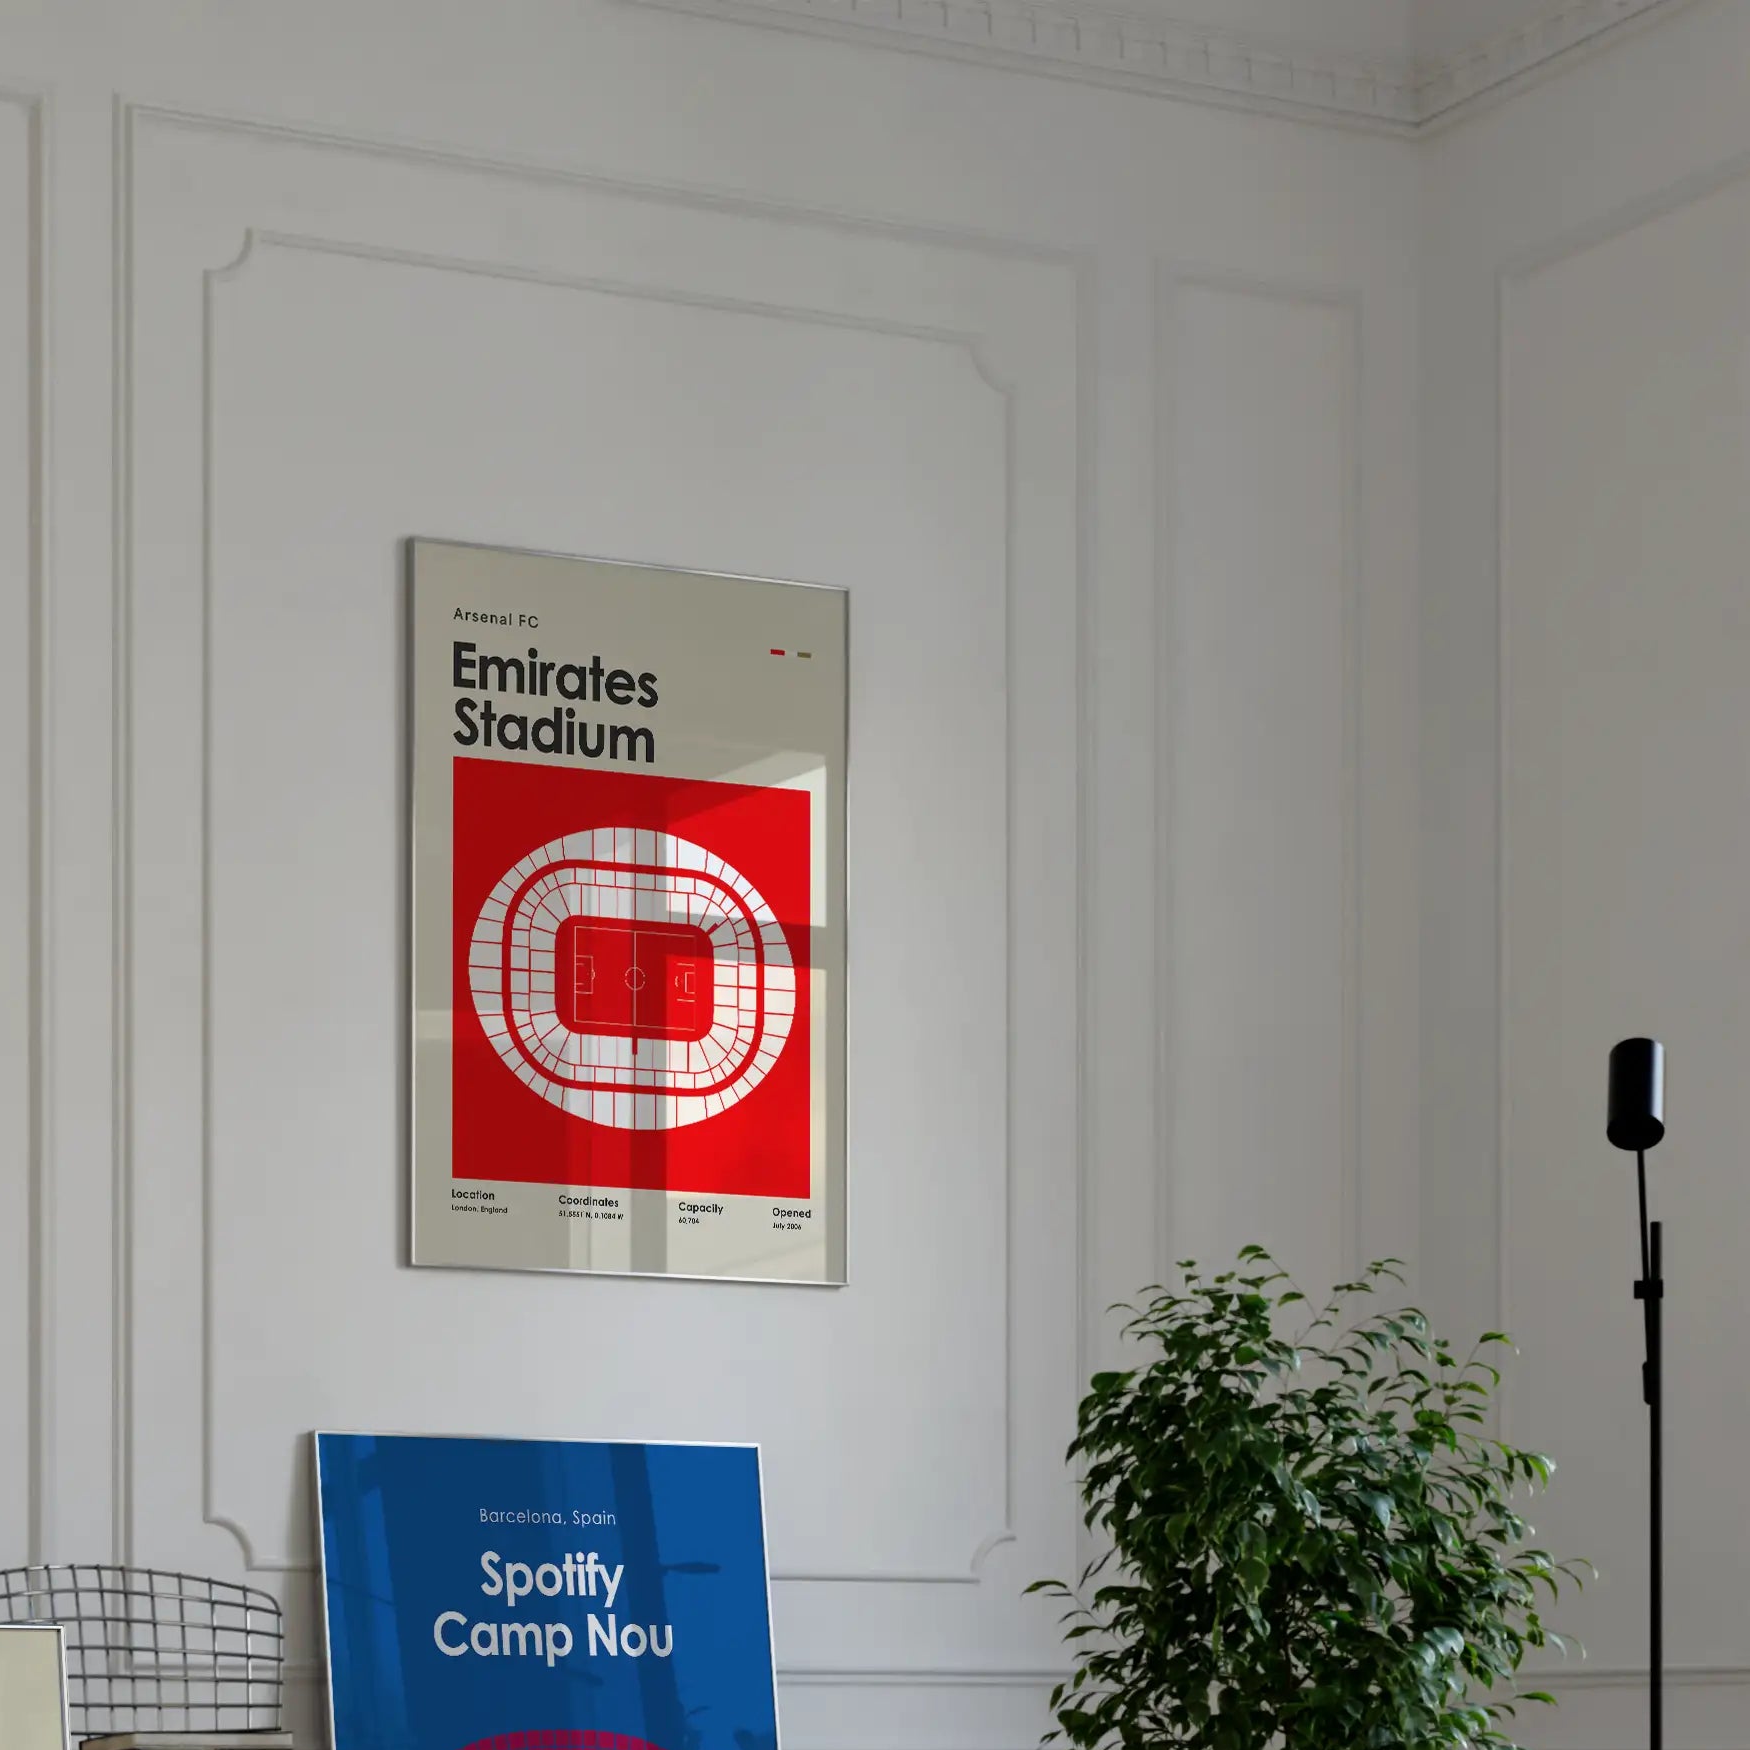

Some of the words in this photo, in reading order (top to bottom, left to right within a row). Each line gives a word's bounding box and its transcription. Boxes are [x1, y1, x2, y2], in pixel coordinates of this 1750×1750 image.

[453, 607, 513, 626] Arsenal
[518, 614, 539, 629] FC
[453, 641, 658, 708] Emirates
[453, 698, 655, 763] Stadium
[451, 1188, 495, 1201] Location
[558, 1194, 619, 1208] Coordinates
[678, 1201, 724, 1216] Capacity
[772, 1207, 812, 1219] Opened
[772, 1222, 786, 1231] July
[479, 1508, 567, 1526] Barcelona,
[572, 1509, 616, 1528] Spain
[481, 1551, 624, 1608] Spotify
[433, 1610, 574, 1668] Camp
[586, 1613, 674, 1658] Nou
